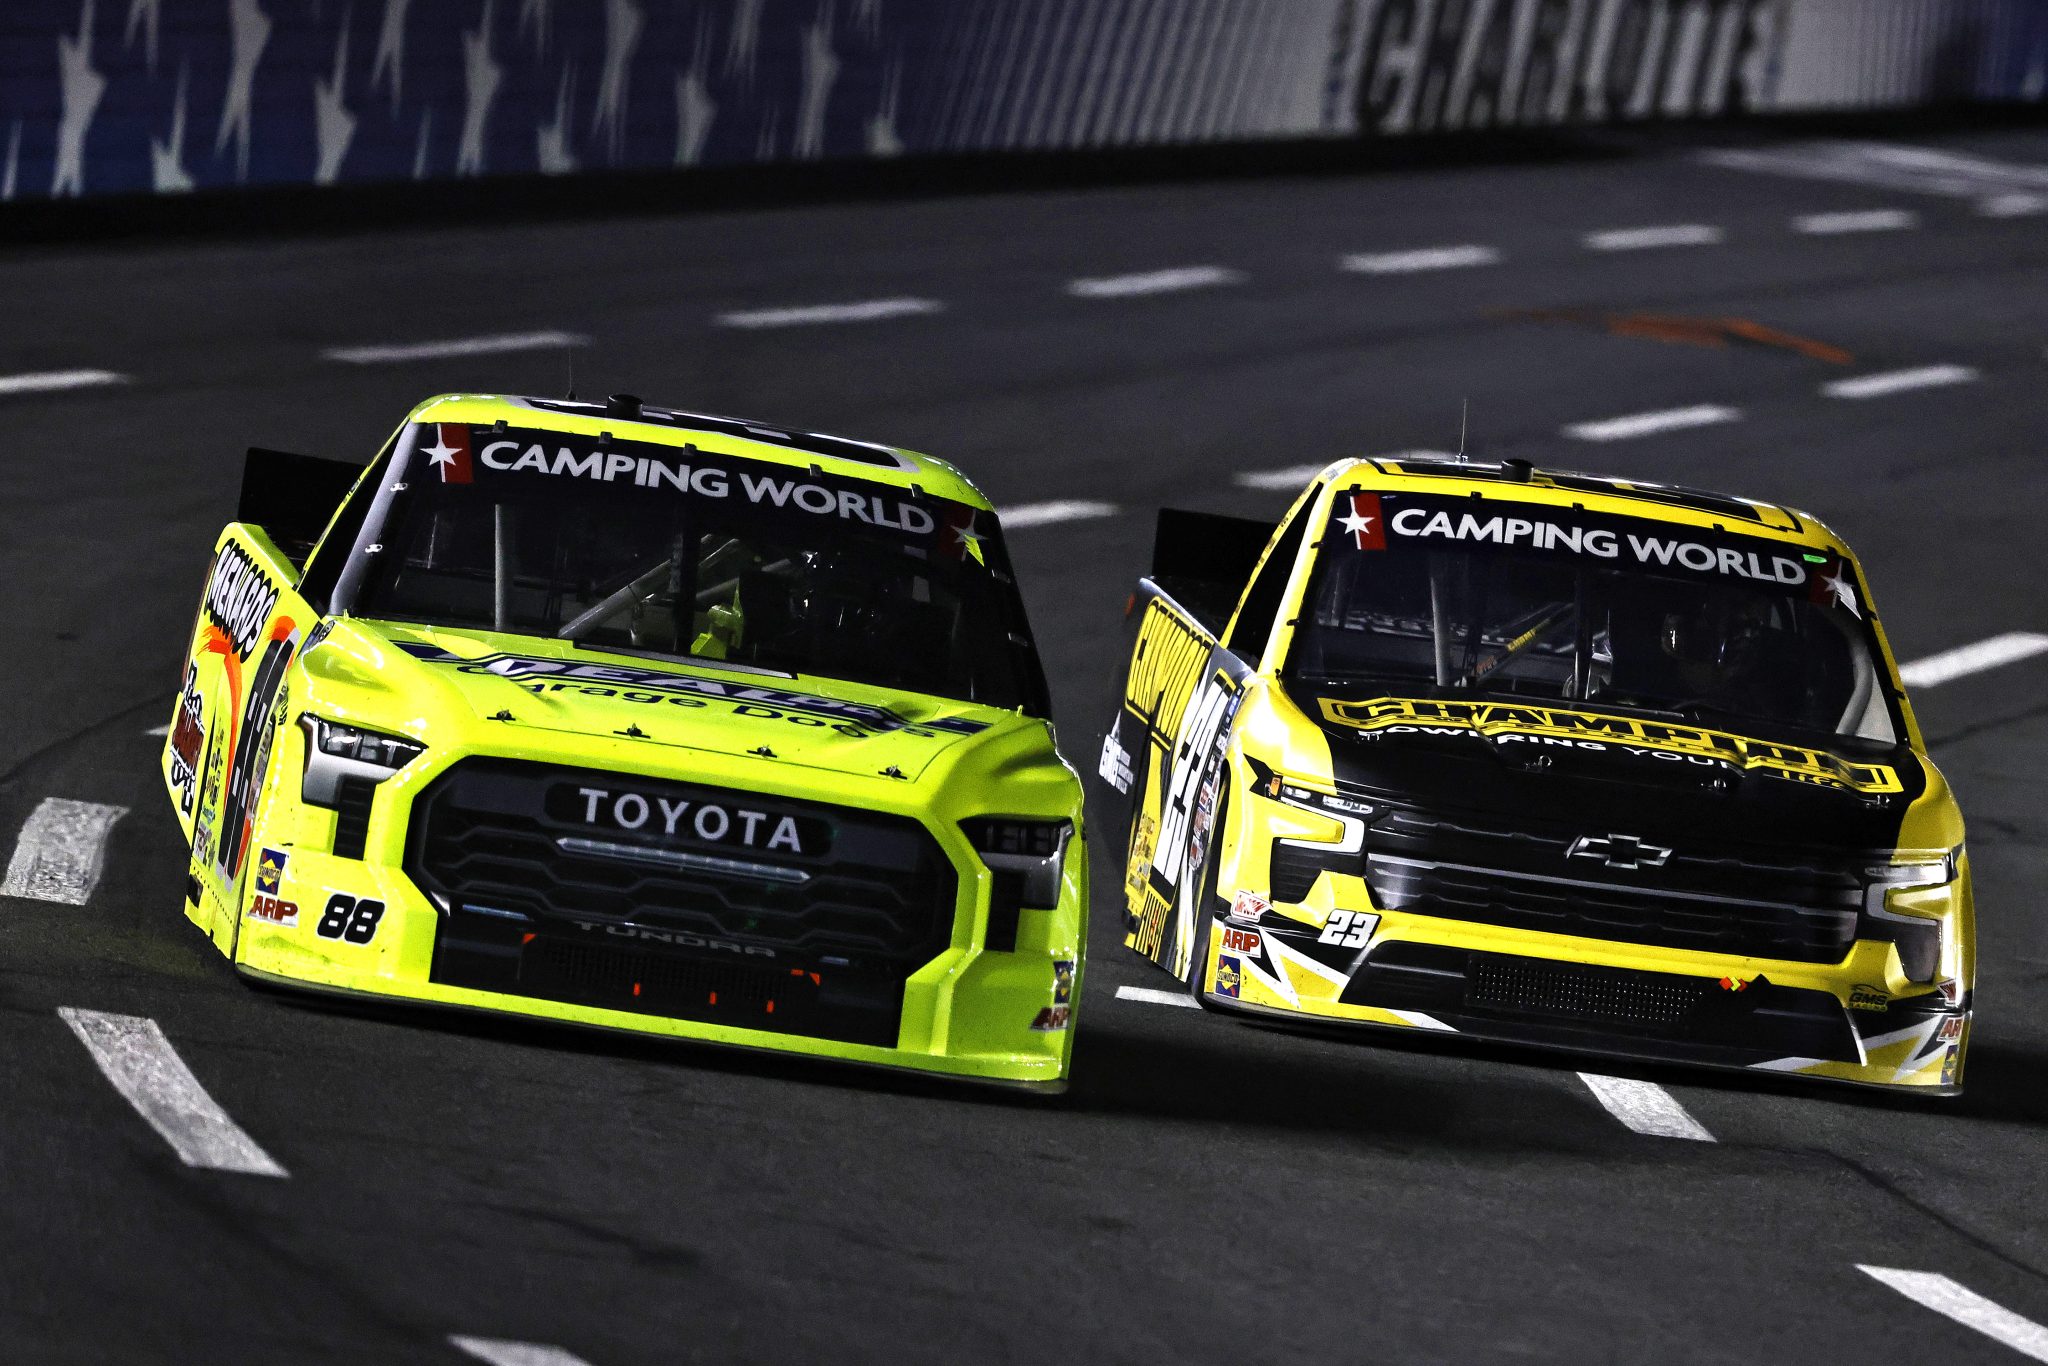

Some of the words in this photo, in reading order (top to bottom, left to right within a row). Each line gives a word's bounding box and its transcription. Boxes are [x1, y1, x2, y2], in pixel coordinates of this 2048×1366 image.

[480, 441, 729, 498] CAMPING
[738, 473, 935, 534] WORLD
[1391, 508, 1619, 558] CAMPING
[1626, 533, 1806, 585] WORLD
[205, 540, 278, 662] MENARDS
[731, 705, 935, 738] Doos
[579, 787, 802, 853] TOYOTA
[250, 895, 299, 922] ARP
[317, 893, 386, 945] 88
[1317, 908, 1383, 949] 23
[1221, 928, 1260, 952] ARP
